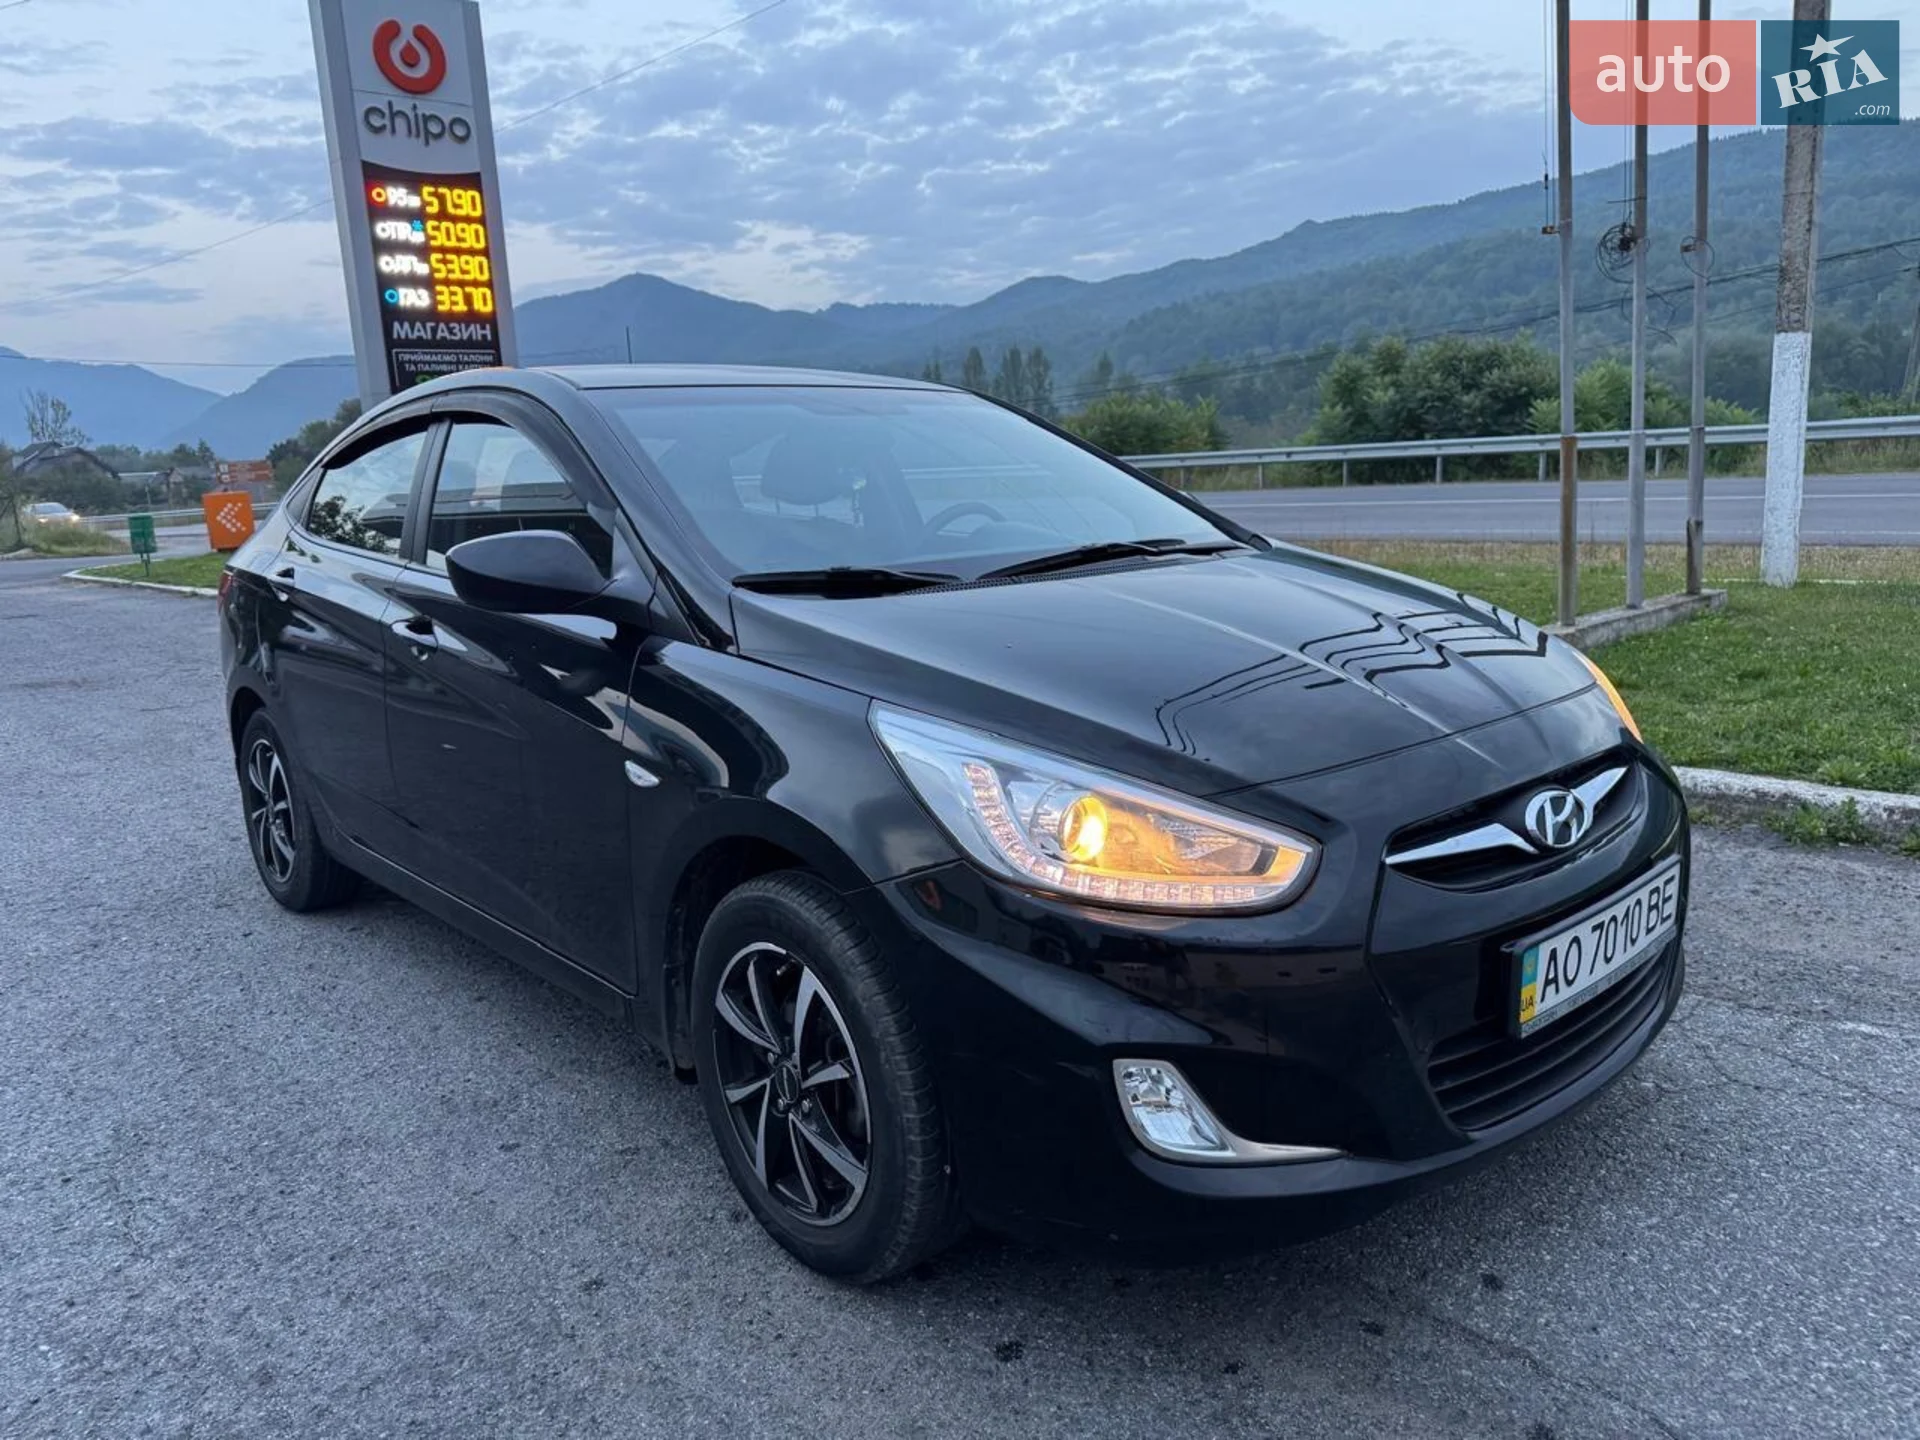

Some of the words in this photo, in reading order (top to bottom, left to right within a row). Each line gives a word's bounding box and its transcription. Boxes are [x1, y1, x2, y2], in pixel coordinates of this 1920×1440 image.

[363, 100, 471, 147] chipo
[392, 321, 492, 341] МАГАЗИН
[1589, 897, 1643, 976] 7010
[1645, 874, 1677, 936] BE
